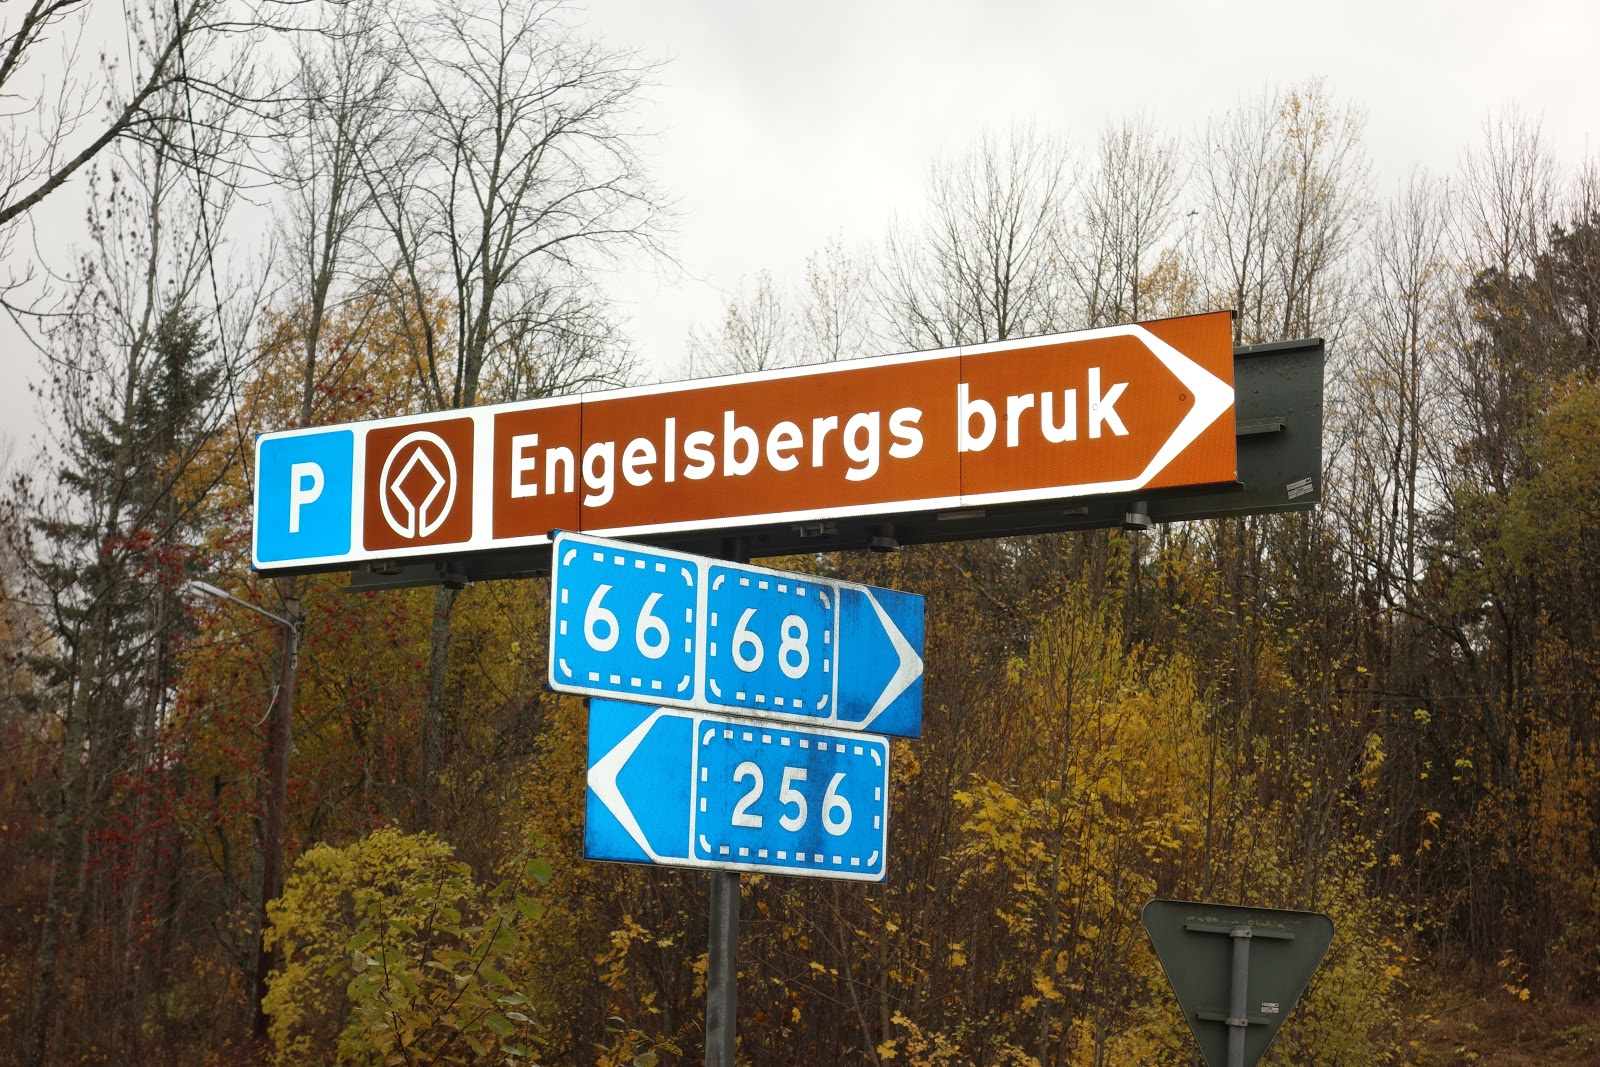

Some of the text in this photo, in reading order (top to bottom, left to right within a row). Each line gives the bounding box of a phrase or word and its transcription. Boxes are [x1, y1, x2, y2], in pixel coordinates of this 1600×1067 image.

[510, 366, 1130, 508] Engelsbergs bruk
[288, 461, 325, 534] P
[583, 583, 671, 660] 66
[730, 607, 810, 680] 68
[730, 761, 853, 837] 256
